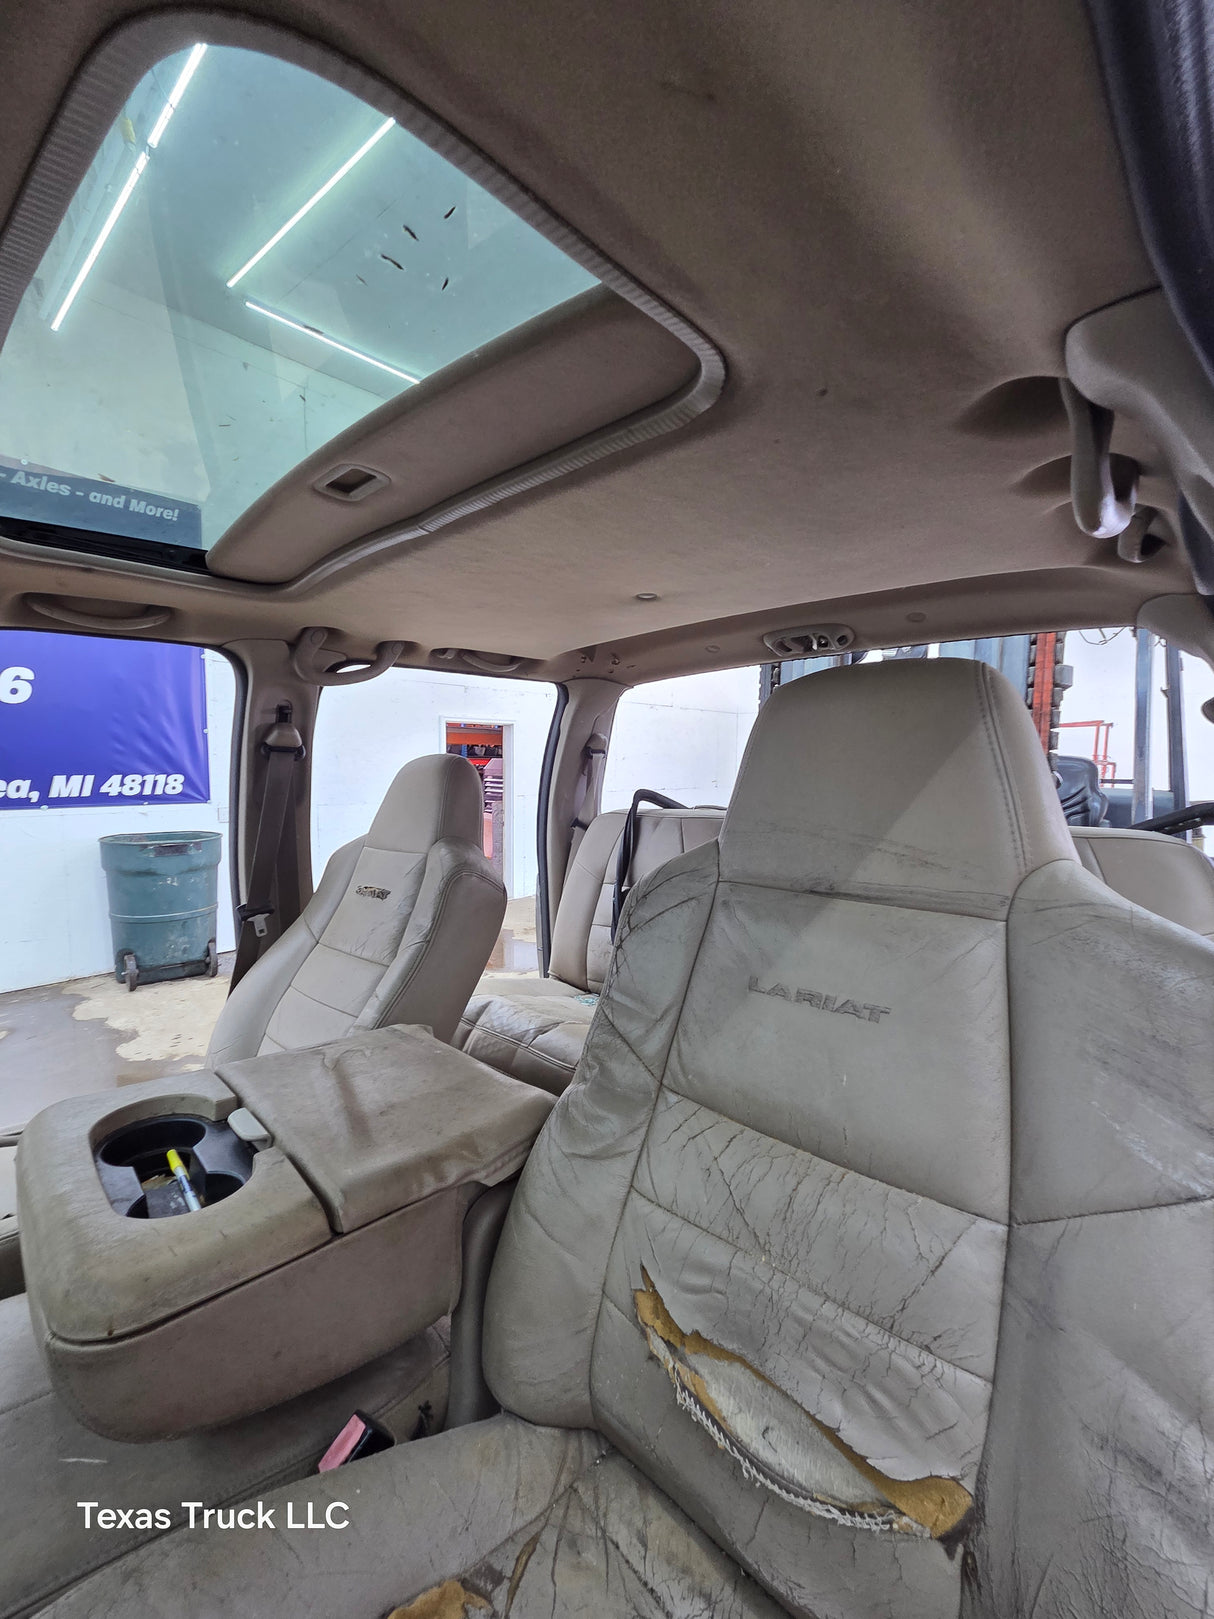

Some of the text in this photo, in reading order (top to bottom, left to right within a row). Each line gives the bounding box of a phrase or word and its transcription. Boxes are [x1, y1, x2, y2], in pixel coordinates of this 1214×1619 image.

[11, 471, 71, 496] Axles
[89, 491, 126, 508] and
[129, 499, 179, 521] More!
[0, 666, 35, 704] 6
[48, 775, 95, 798] MI
[99, 774, 185, 796] 48118
[747, 975, 893, 1024] LARIAT
